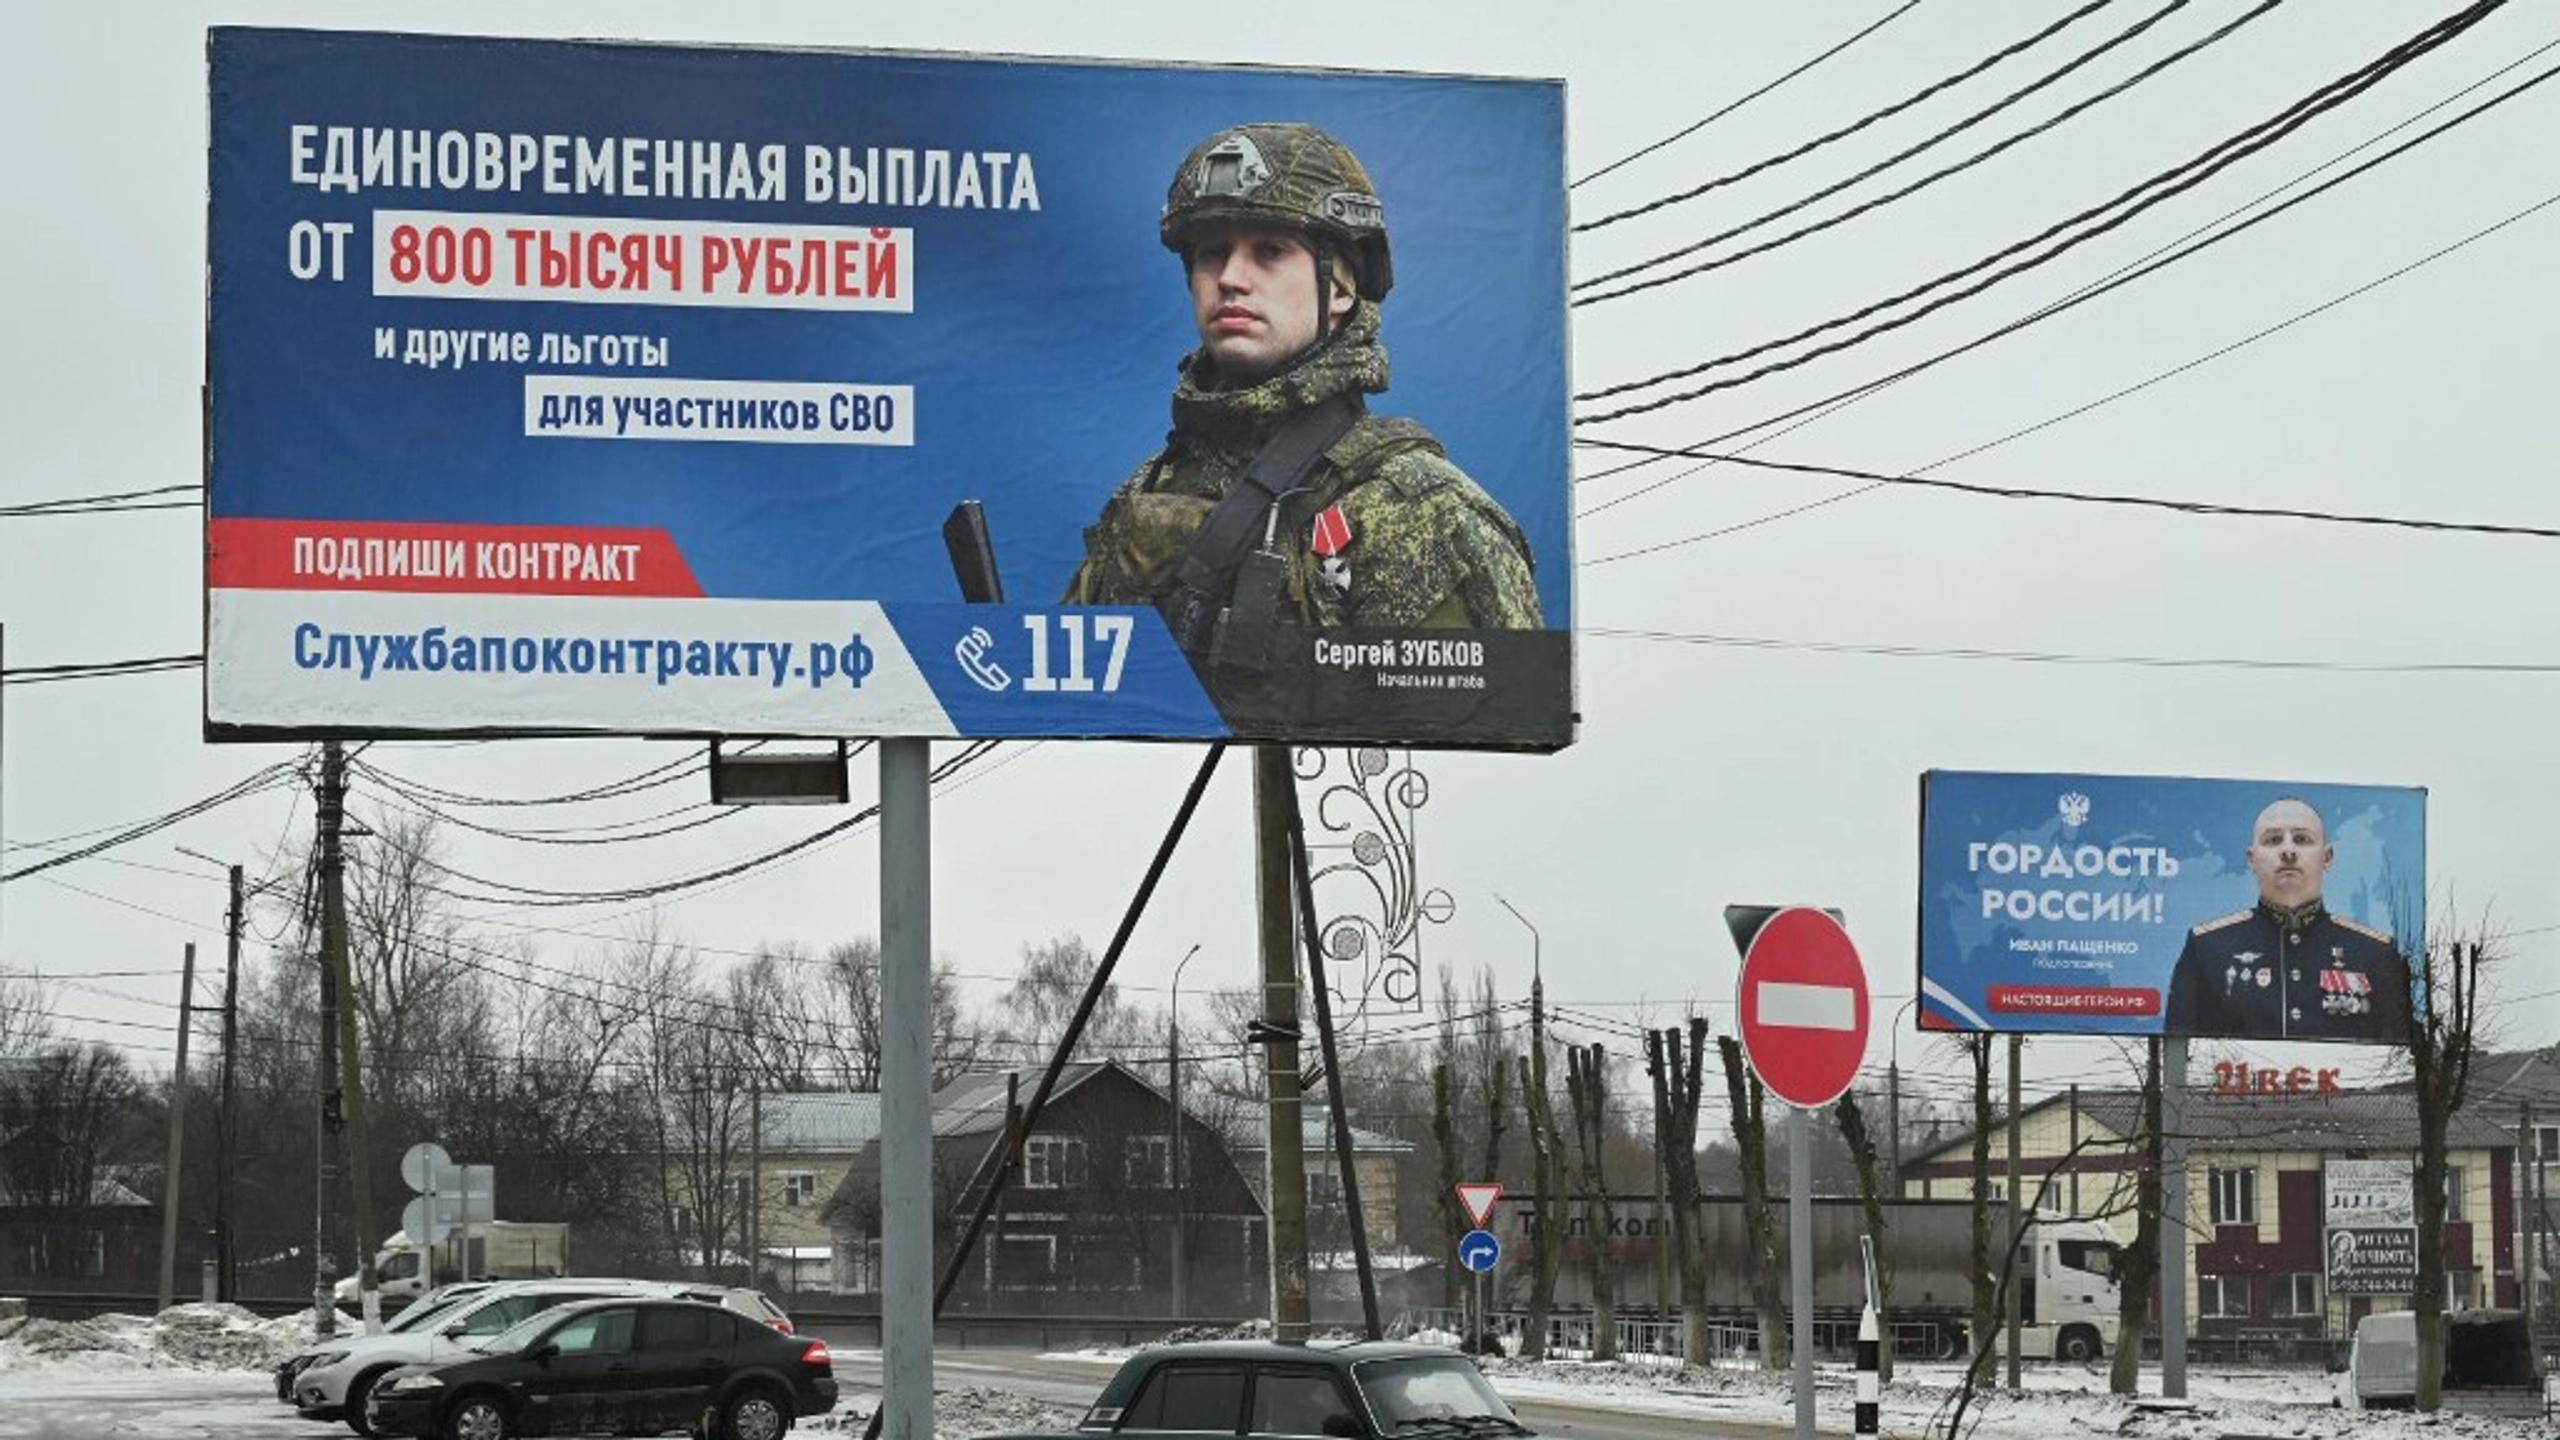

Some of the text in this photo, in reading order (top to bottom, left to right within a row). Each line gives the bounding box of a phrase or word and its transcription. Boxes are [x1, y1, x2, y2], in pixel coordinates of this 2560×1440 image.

[291, 124, 1041, 211] ЕДИНОВРЕМЕННАЯ ВЫПЛАТА
[289, 220, 896, 299] ОТ 800 ТЫСЯЧ РУБЛЕЙ
[374, 327, 669, 369] и другие льготы
[539, 392, 894, 434] для участников СВО
[294, 536, 641, 581] ПОДПИШИ КОНТРАКТ
[294, 621, 875, 688] Службапоконтракту.рф
[1023, 614, 1134, 692] 117
[1314, 637, 1485, 671] Сергей ЗУБКОВ
[1968, 842, 2179, 878] ГОРДОСТЬ
[1982, 888, 2163, 924] РОССИИ!
[2009, 938, 2139, 954] ИВАН ПАЩЕНКО
